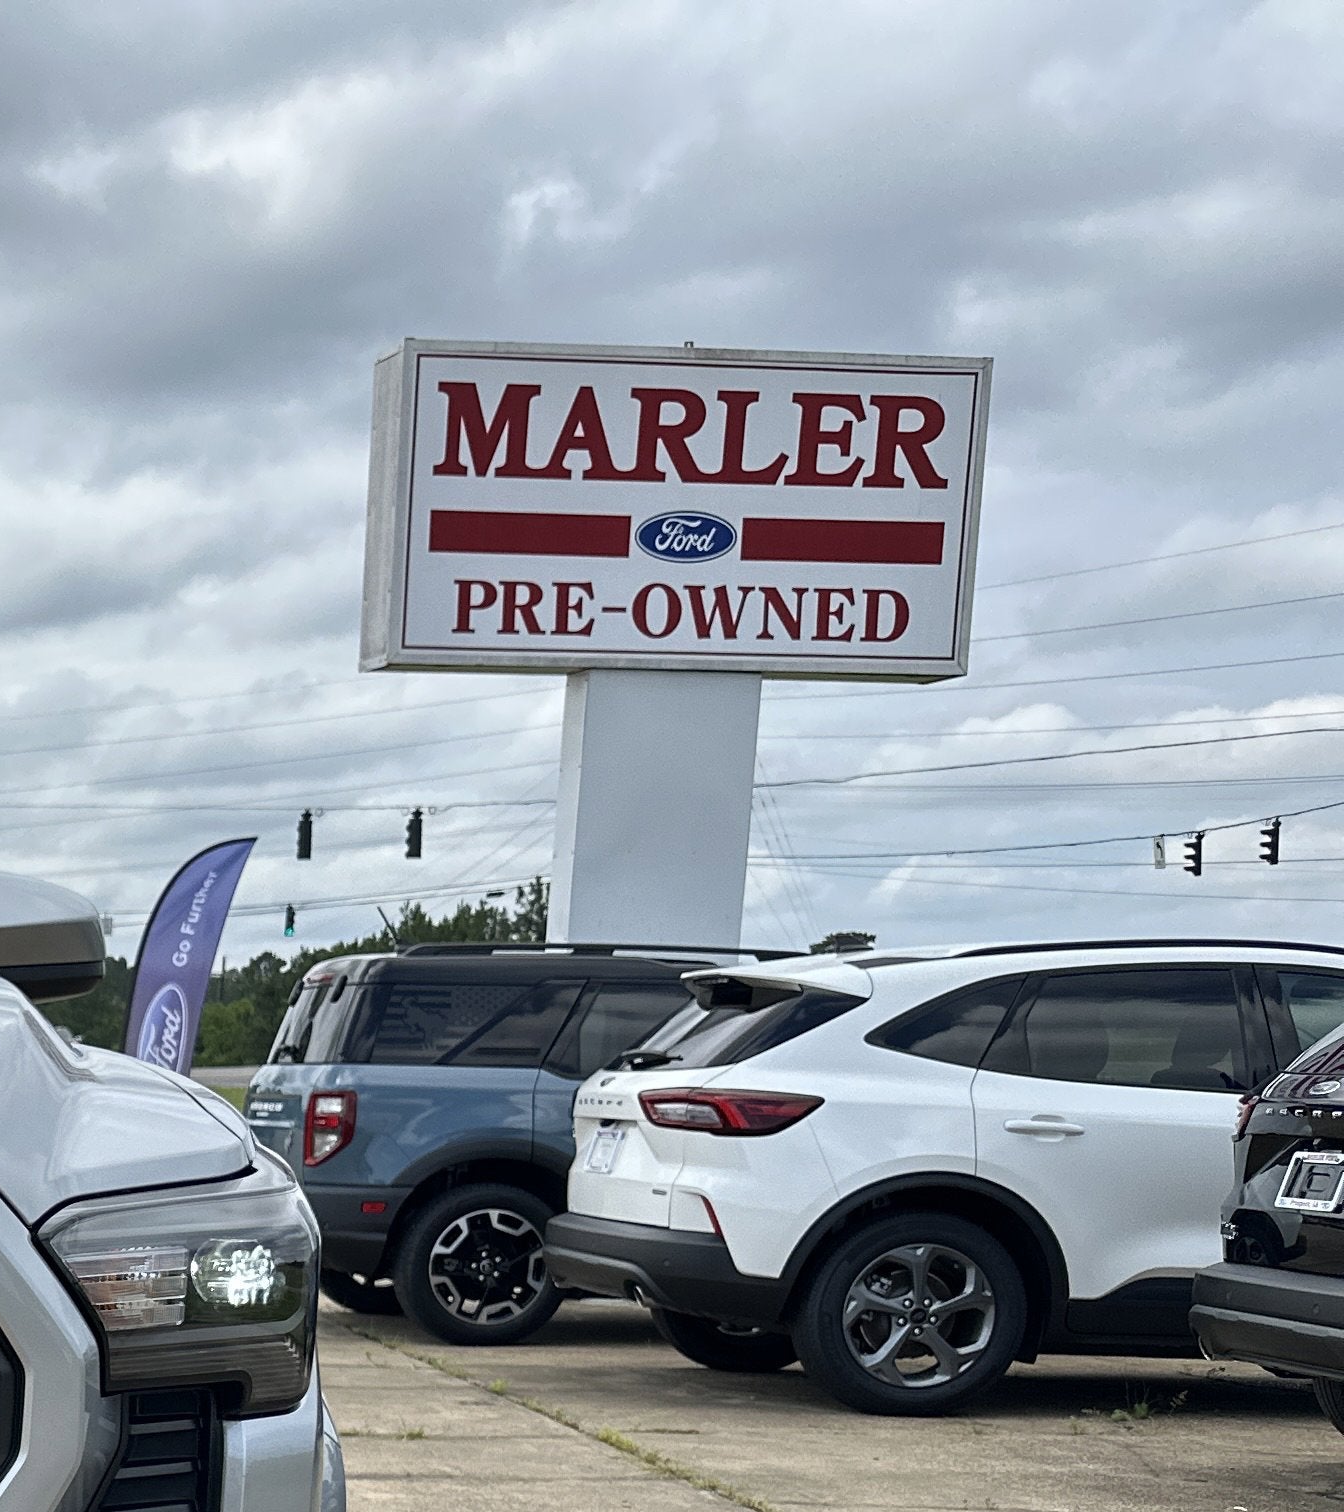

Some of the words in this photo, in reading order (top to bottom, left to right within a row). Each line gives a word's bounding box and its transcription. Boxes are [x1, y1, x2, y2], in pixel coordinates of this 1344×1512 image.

[432, 381, 948, 489] MARLER
[654, 517, 717, 552] Ford
[451, 579, 910, 643] PRE-OWNED
[180, 871, 217, 936] Further
[172, 939, 192, 968] Go
[143, 1005, 182, 1071] Ford
